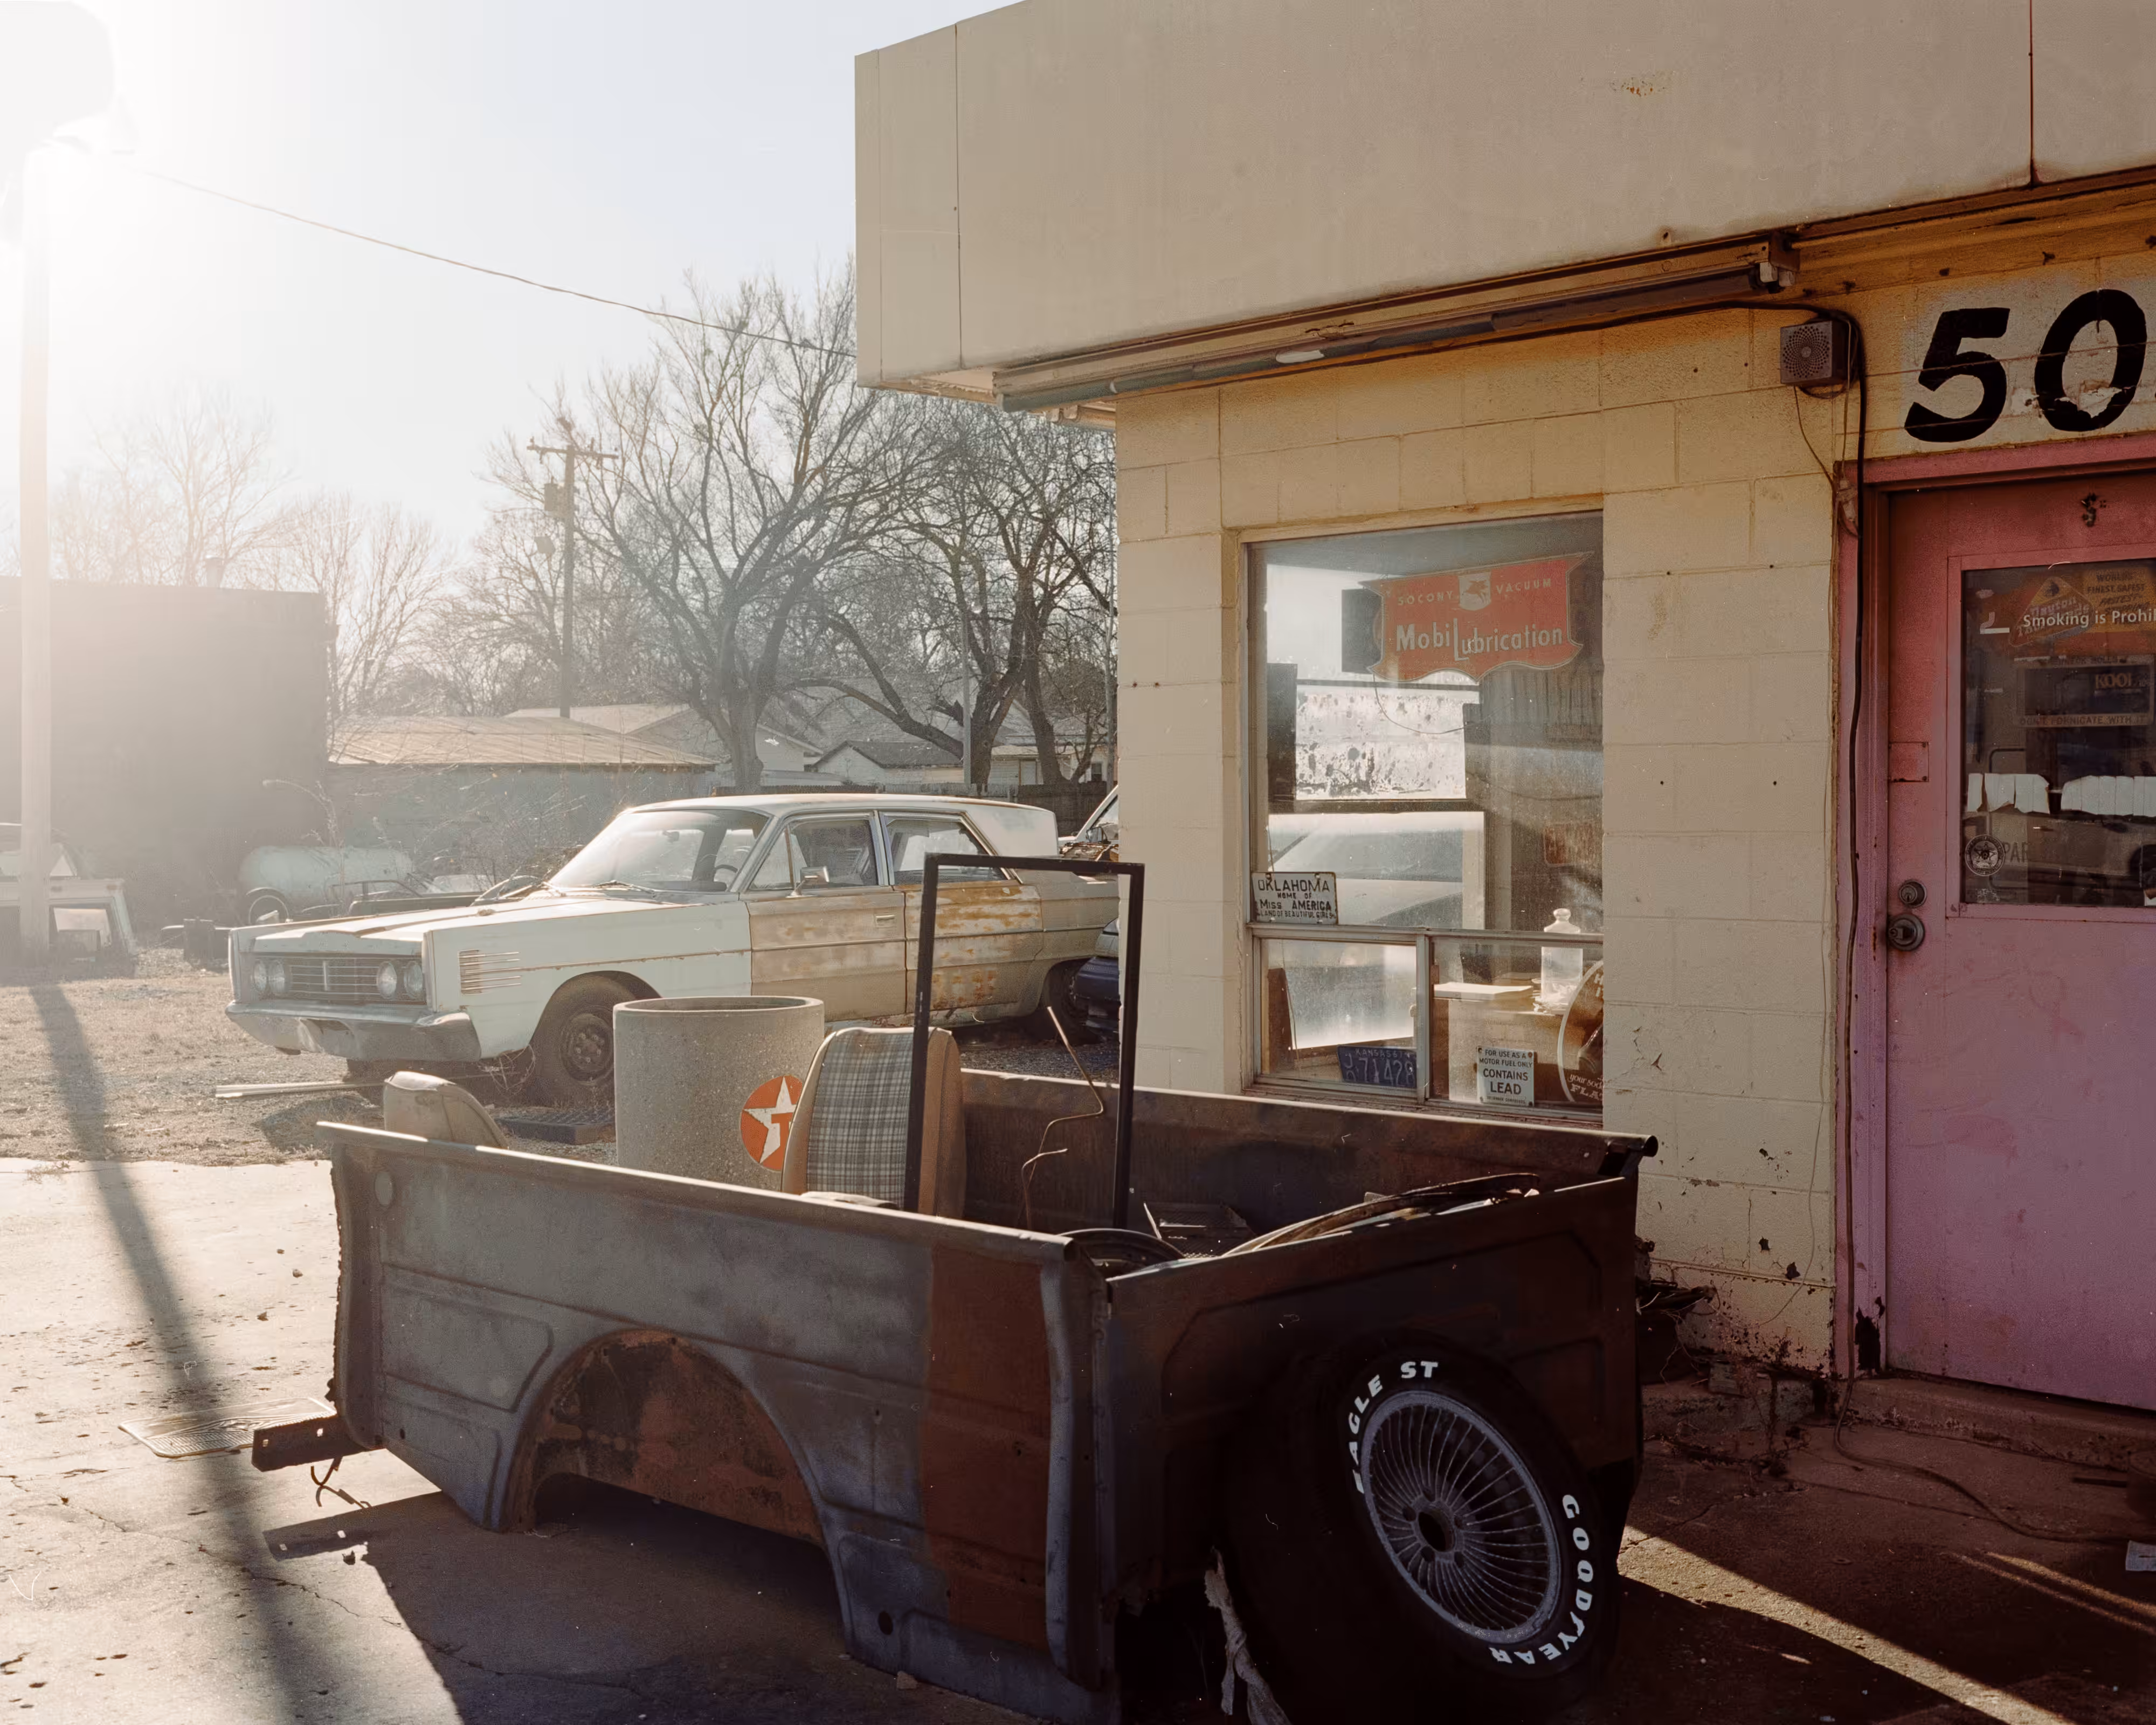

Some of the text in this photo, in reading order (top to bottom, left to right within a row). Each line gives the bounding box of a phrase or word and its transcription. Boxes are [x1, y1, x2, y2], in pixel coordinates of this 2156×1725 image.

[1496, 578, 1552, 594] VACUUM
[2023, 613, 2089, 628] Smoking
[2095, 610, 2106, 624] is
[1395, 618, 1563, 661] MobiLubrication
[1258, 879, 1330, 892] OKLAHOMA
[1292, 900, 1332, 911] AMERICA
[1355, 1048, 1392, 1058] KANSAS
[1483, 1068, 1528, 1081] CONTAINS
[1490, 1081, 1522, 1095] LEAD
[1349, 1360, 1438, 1495] EAGLE ST
[1489, 1494, 1594, 1665] GOODYEAR
